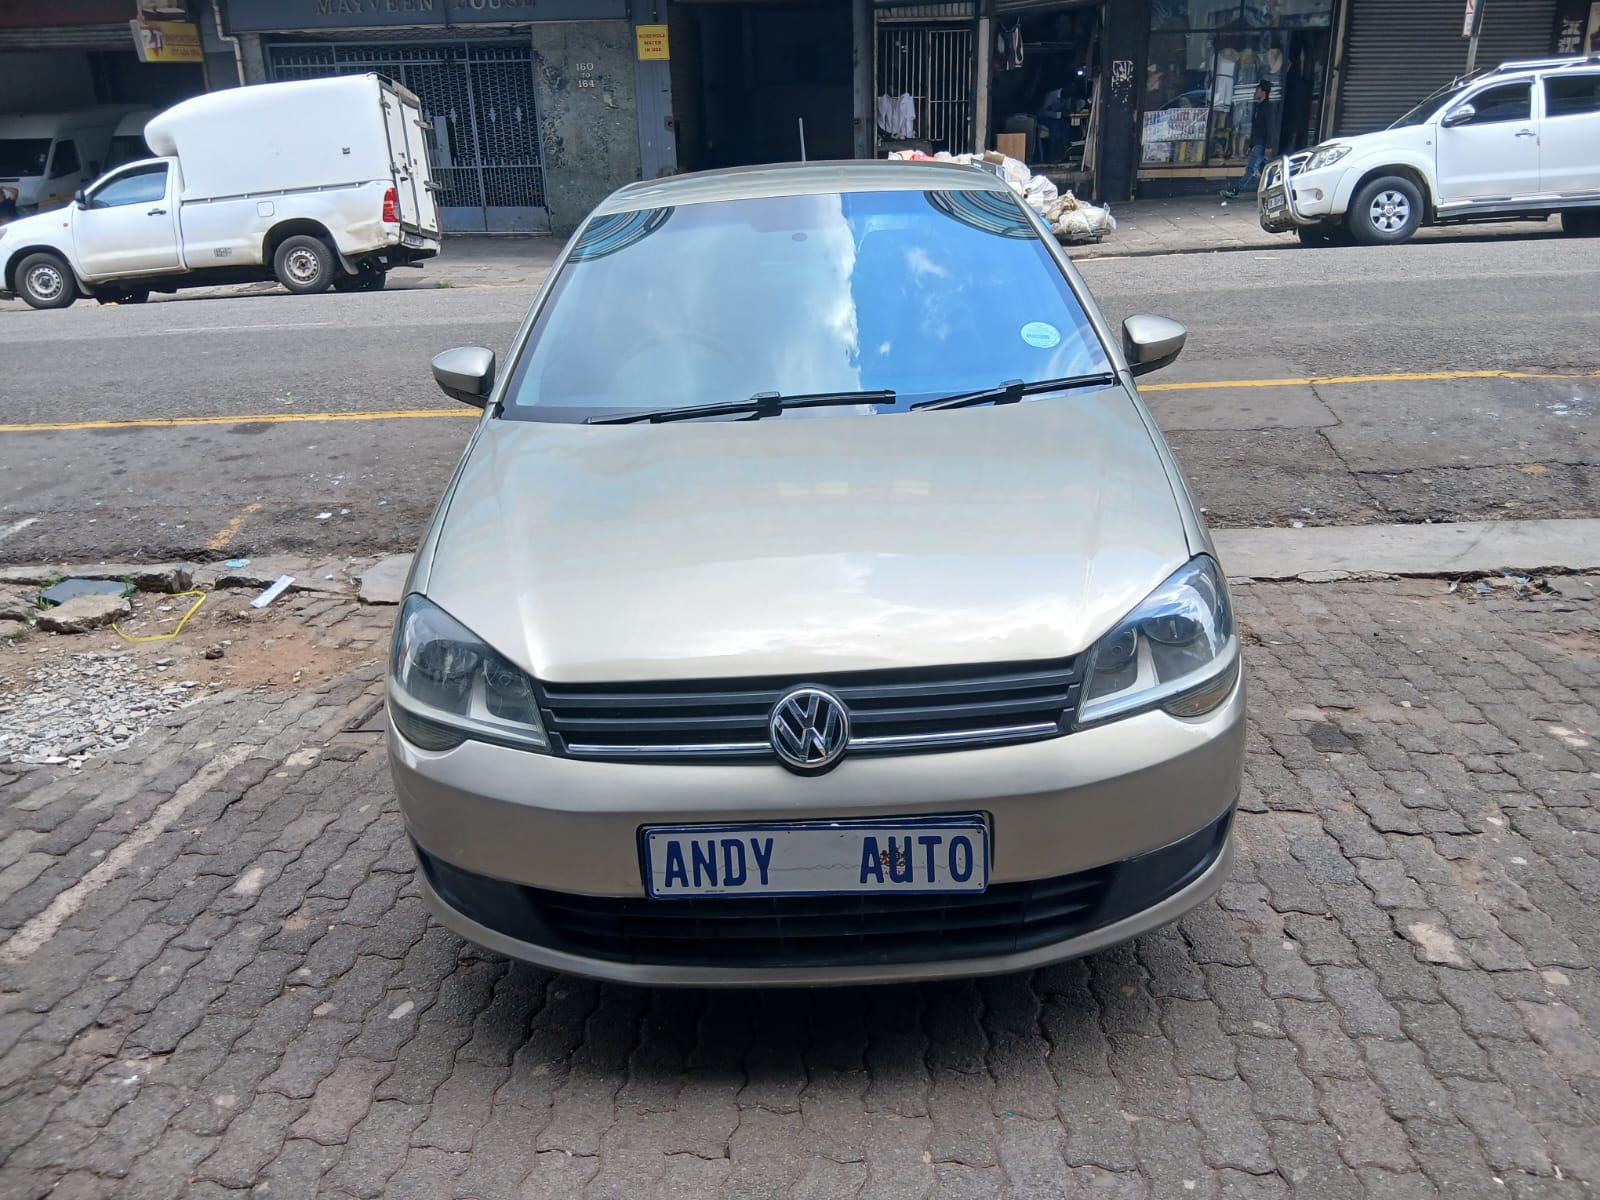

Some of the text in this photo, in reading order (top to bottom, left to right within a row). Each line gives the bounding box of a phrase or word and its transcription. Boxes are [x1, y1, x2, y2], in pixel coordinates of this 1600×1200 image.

[576, 62, 594, 71] 160
[578, 79, 595, 88] 164
[664, 835, 974, 888] ANDY AUTO
